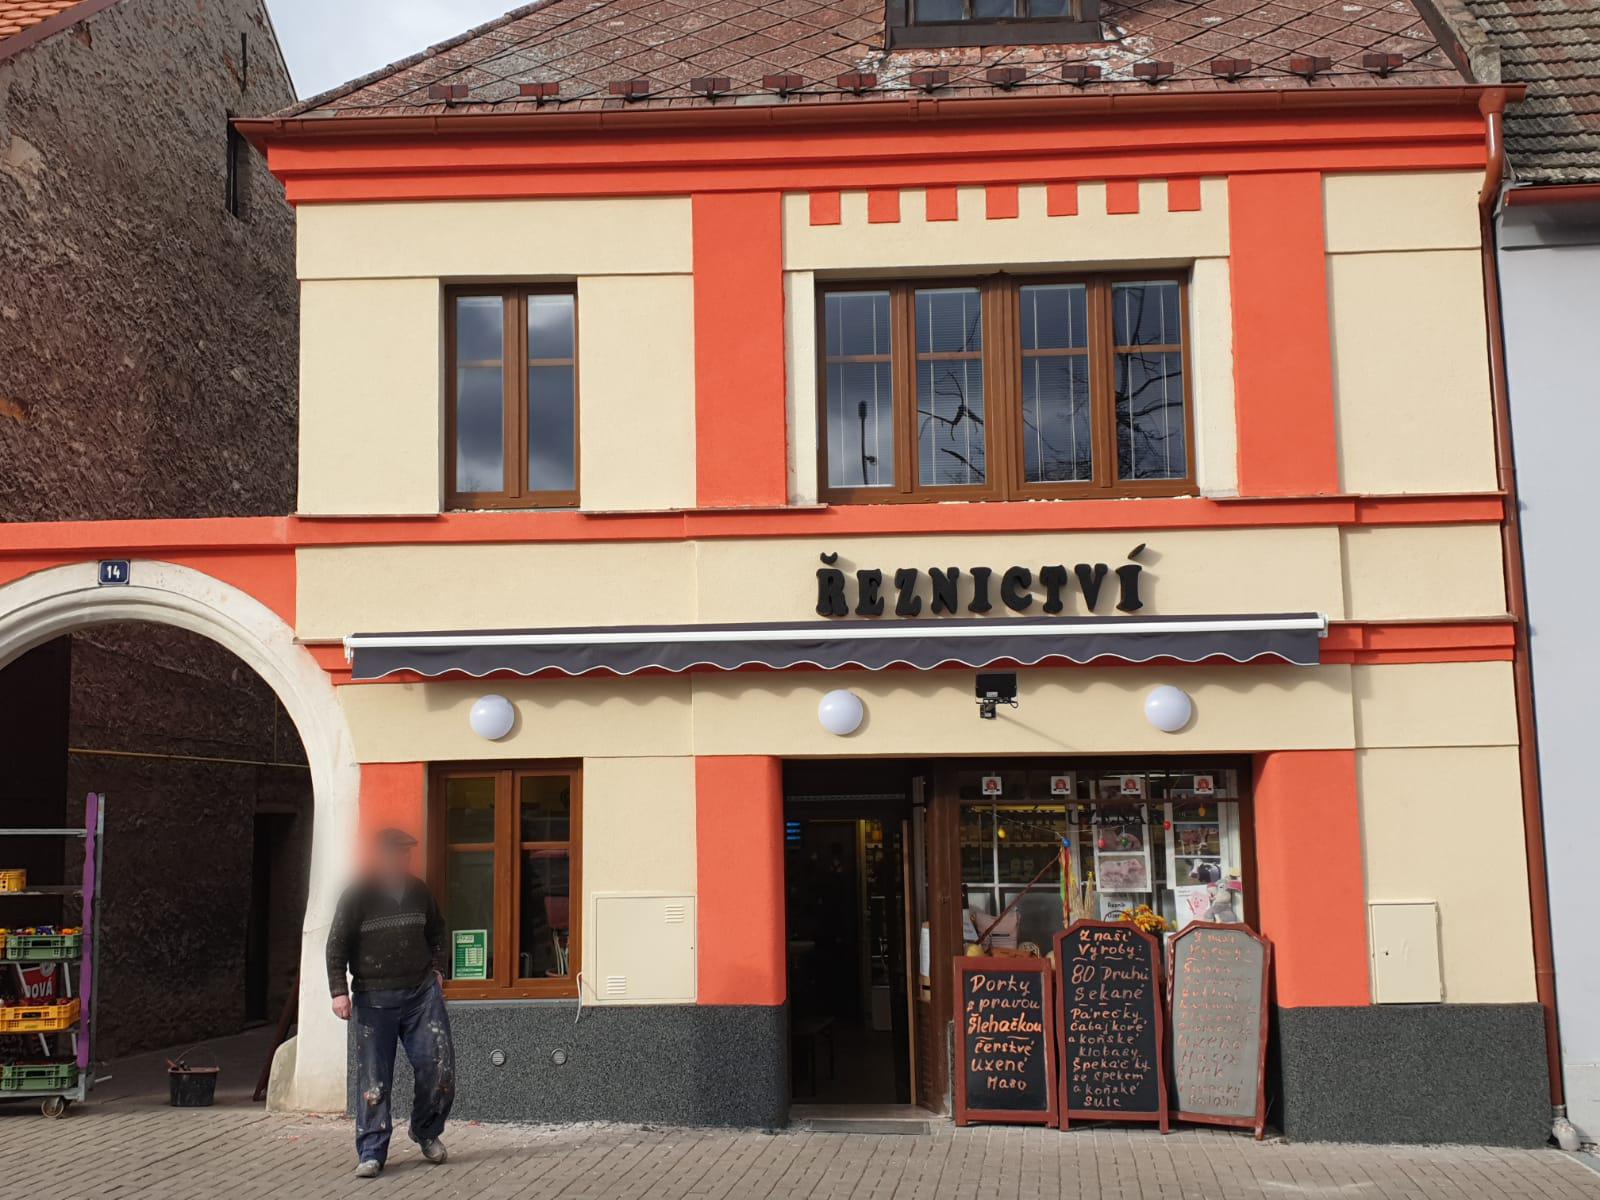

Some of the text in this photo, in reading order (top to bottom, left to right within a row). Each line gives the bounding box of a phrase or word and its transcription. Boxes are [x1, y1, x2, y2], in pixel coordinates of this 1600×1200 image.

[106, 565, 120, 579] 14
[815, 543, 1147, 616] ŘEZNICTVÍ
[1071, 964, 1095, 985] 80
[979, 998, 1040, 1012] pravou
